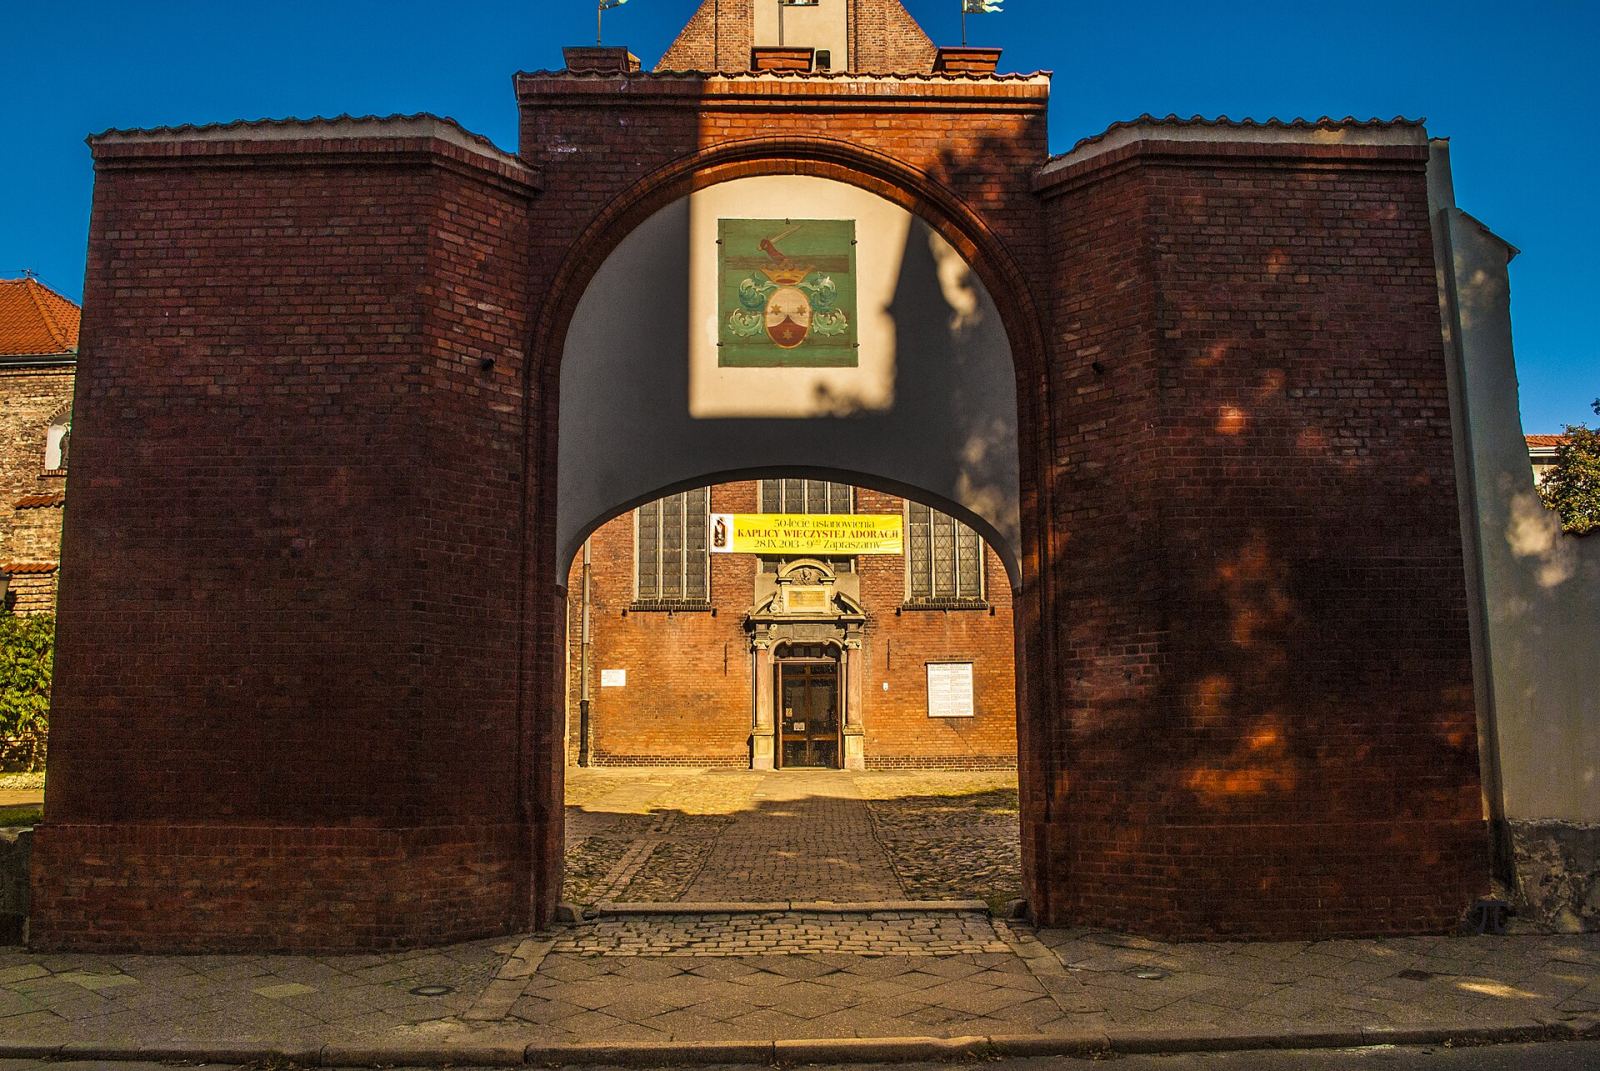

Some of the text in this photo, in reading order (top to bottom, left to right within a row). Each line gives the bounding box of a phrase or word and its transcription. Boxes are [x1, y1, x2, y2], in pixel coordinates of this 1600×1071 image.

[774, 518, 875, 529] 50-lecie ustanowienia
[737, 528, 899, 539] KAPLICY WIECZYSTEJ ADORACJI
[823, 539, 881, 552] Zapraszamy
